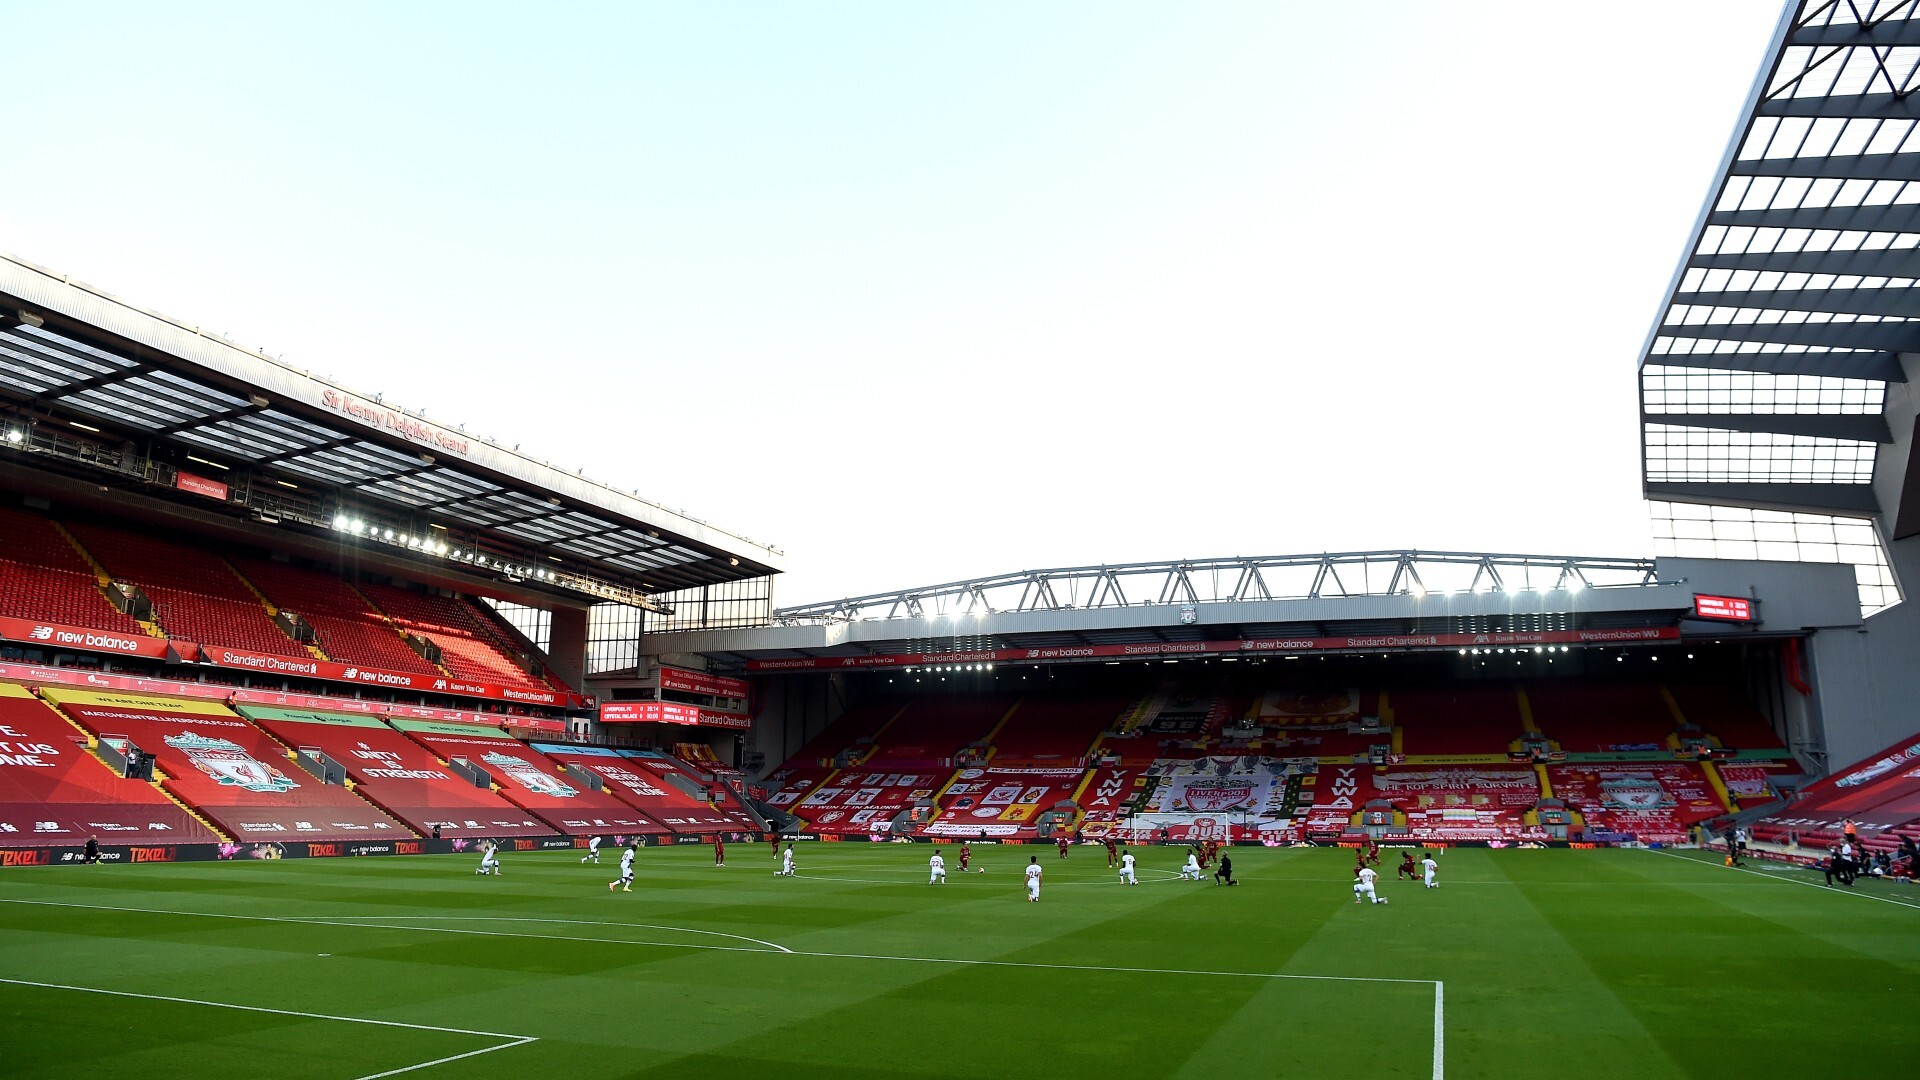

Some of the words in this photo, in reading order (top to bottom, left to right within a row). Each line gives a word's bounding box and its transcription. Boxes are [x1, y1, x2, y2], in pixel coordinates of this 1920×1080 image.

[322, 389, 341, 409] Sir
[343, 396, 384, 428] Kenny
[386, 412, 434, 441] Dalglish
[435, 431, 469, 456] Stand
[56, 631, 84, 643] new
[85, 633, 137, 651] balance
[1276, 640, 1313, 648] balance
[1347, 637, 1386, 647] Standard
[1387, 637, 1429, 645] Chartered
[1473, 634, 1490, 643] AXA
[1515, 634, 1527, 642] You
[1059, 648, 1094, 656] balance
[1125, 645, 1160, 654] Standard
[1161, 643, 1199, 652] Chartered
[223, 652, 266, 668] Standard
[267, 658, 310, 673] Chartered
[842, 658, 855, 666] AXA
[922, 653, 953, 662] Standard
[955, 652, 990, 661] Chartered
[359, 671, 377, 681] new
[378, 672, 411, 685] balance
[432, 679, 447, 691] AXA
[450, 683, 465, 691] Know
[465, 684, 475, 692] You
[475, 685, 485, 693] Can
[699, 713, 723, 724] Standard
[723, 716, 747, 727] Chartered
[16, 742, 60, 755] US
[350, 750, 403, 761] UNITY
[381, 760, 403, 769] IS
[361, 768, 450, 780] STRENGTH
[1433, 782, 1470, 790] SPIRIT
[1476, 782, 1538, 790] SURVIVES
[1190, 789, 1247, 797] LIVERPOOL
[1188, 826, 1225, 837] OUR
[370, 845, 389, 853] balance
[1368, 874, 1372, 882] 2
